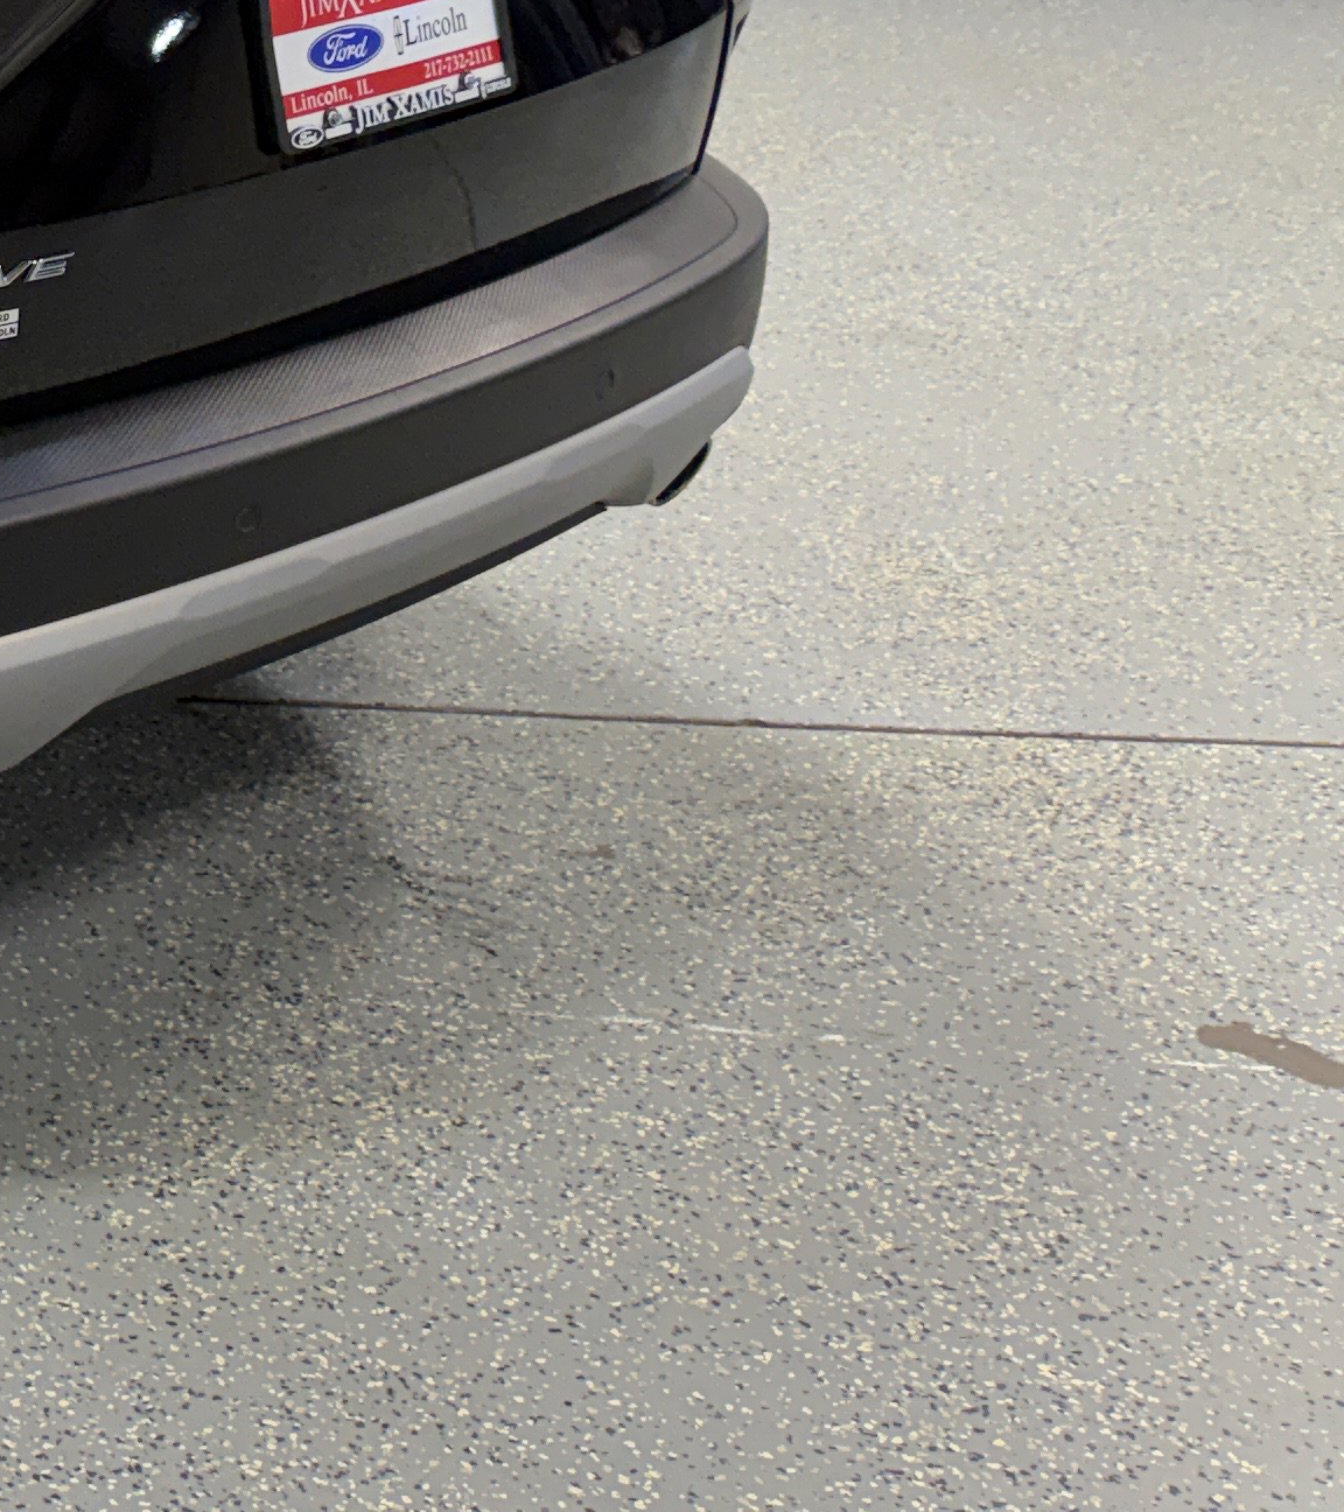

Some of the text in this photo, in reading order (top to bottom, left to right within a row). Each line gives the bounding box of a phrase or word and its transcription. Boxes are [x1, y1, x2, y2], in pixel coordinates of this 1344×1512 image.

[404, 7, 468, 46] Lincoln
[323, 32, 369, 66] Ford
[424, 47, 494, 79] 217-732-2111
[290, 79, 374, 114] Lincoln, IL
[354, 102, 390, 135] JIM
[393, 85, 455, 120] XAMIS
